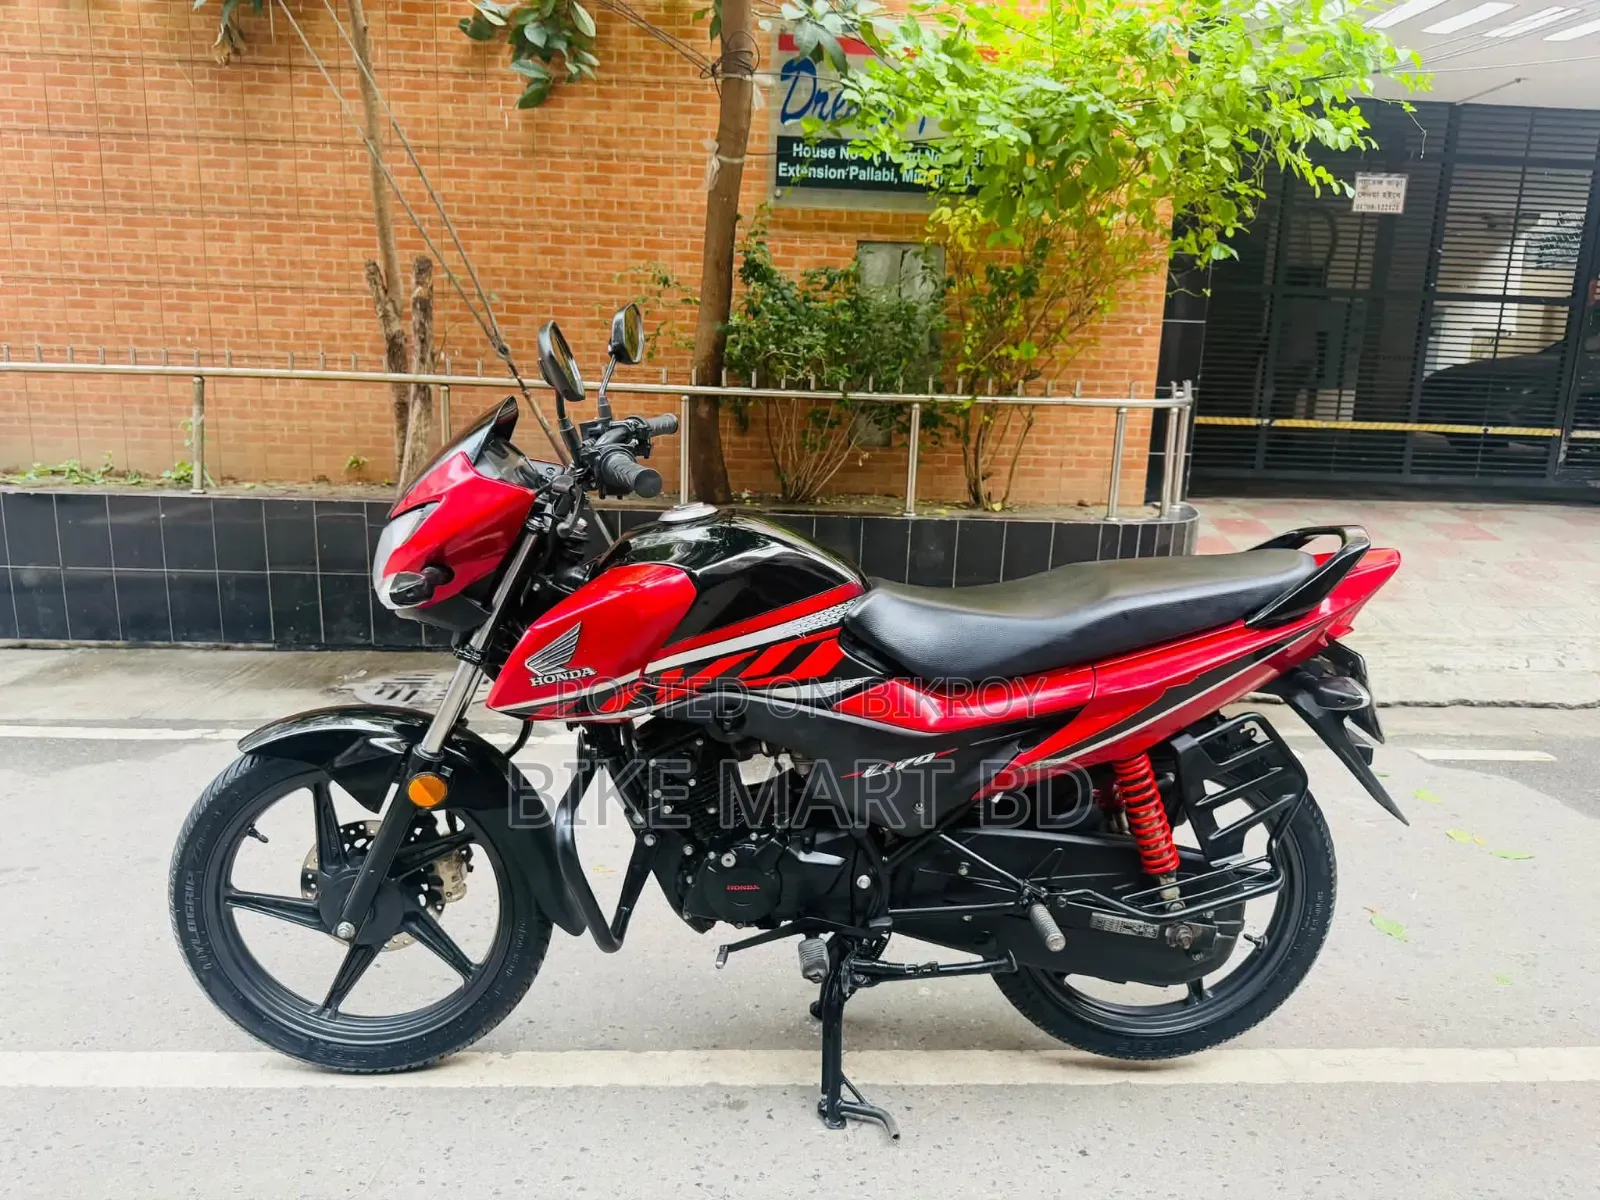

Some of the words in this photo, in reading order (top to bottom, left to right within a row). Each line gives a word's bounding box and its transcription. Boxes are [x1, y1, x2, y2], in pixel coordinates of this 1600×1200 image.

[792, 142, 837, 159] House
[778, 161, 846, 180] Extension
[849, 165, 898, 185] Pallabi,
[529, 667, 598, 687] HONDA
[726, 884, 760, 892] HONDA
